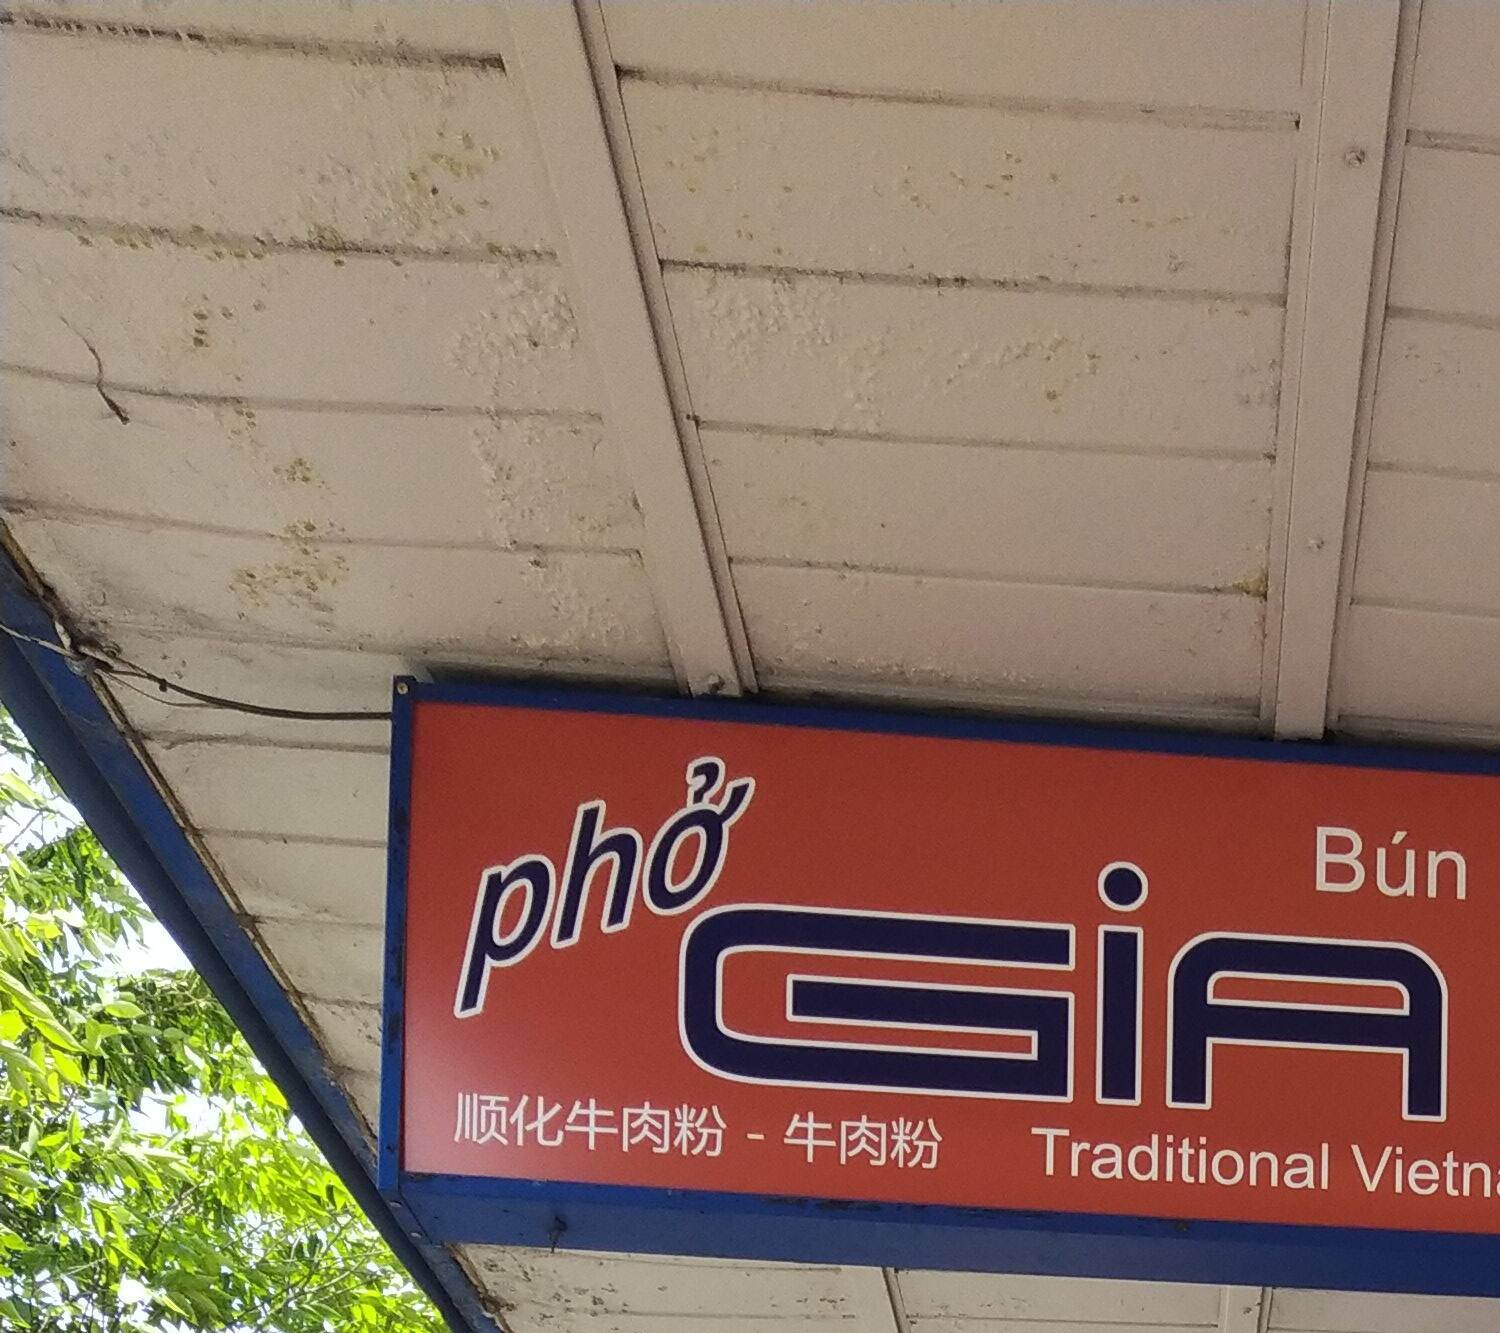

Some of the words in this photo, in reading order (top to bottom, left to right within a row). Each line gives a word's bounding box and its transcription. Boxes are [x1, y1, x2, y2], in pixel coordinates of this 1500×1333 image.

[1313, 825, 1468, 900] Bún
[453, 1092, 726, 1159] 顺化牛肉粉
[782, 1112, 944, 1170] 牛肉粉
[1031, 1126, 1331, 1192] Traditional
